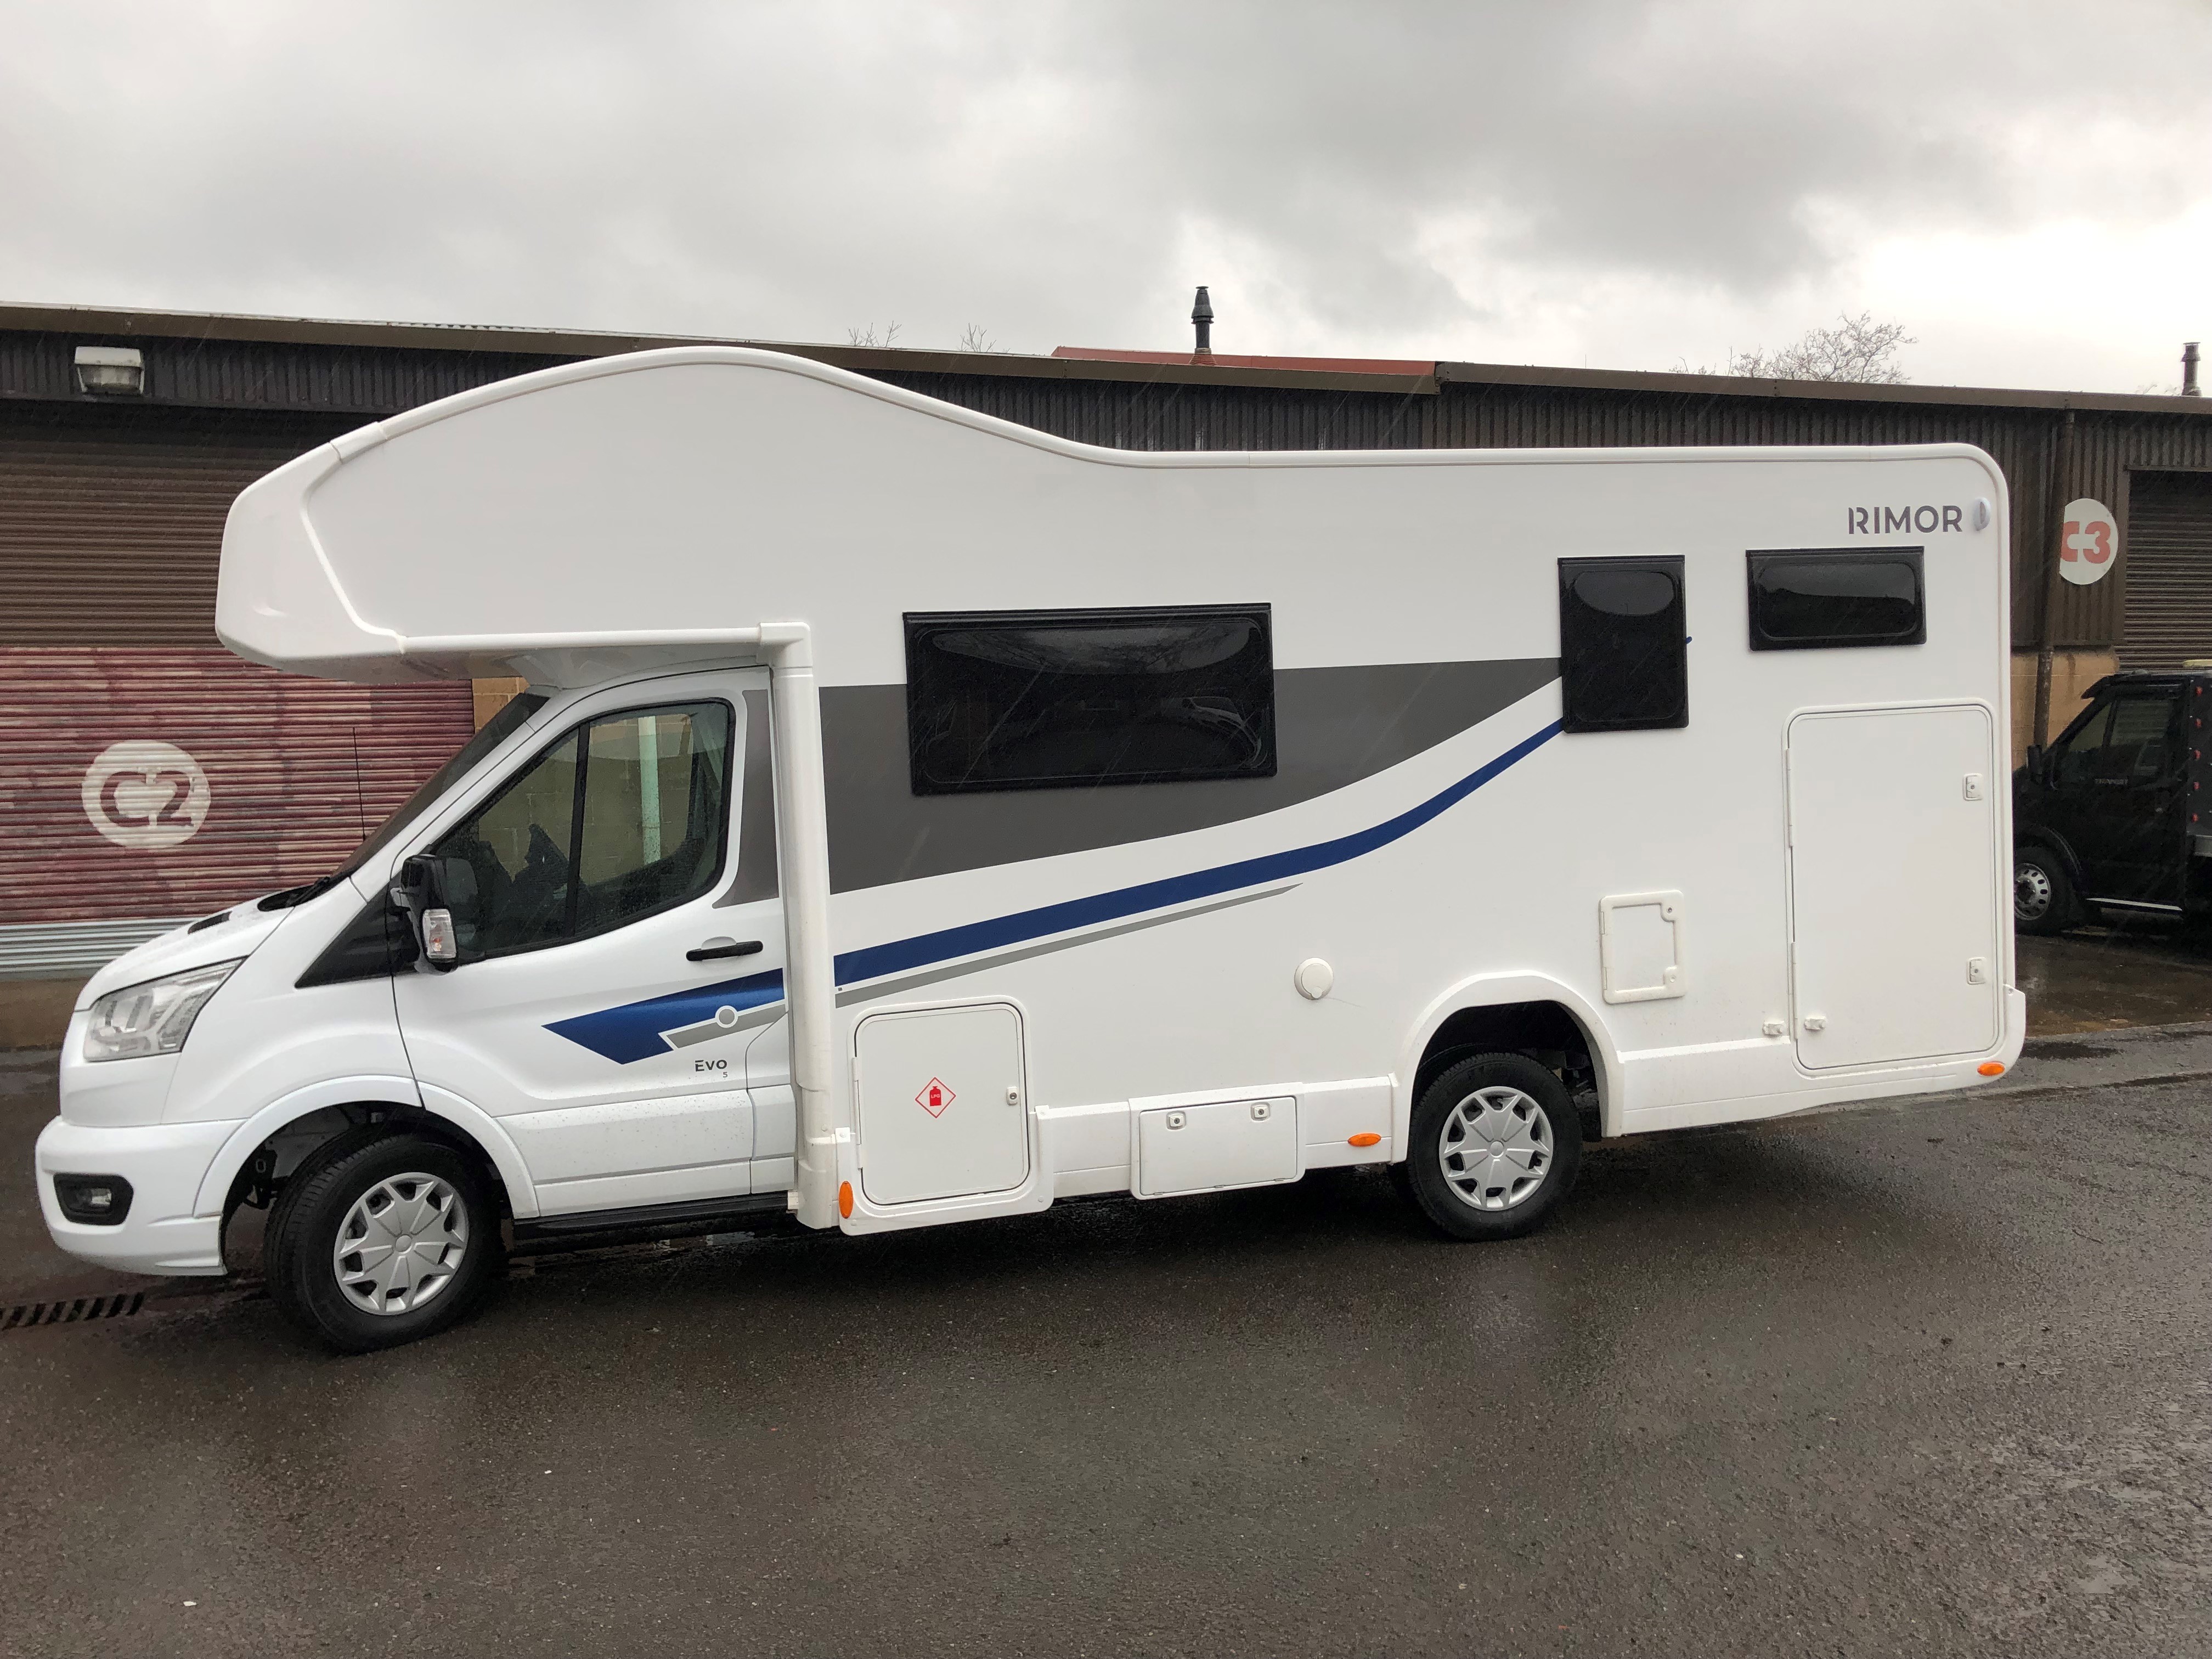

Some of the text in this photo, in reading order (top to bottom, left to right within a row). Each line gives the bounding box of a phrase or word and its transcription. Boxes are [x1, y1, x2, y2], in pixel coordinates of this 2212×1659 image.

[1848, 505, 1962, 534] RIMOR
[2061, 521, 2111, 563] C3
[100, 770, 194, 827] C2
